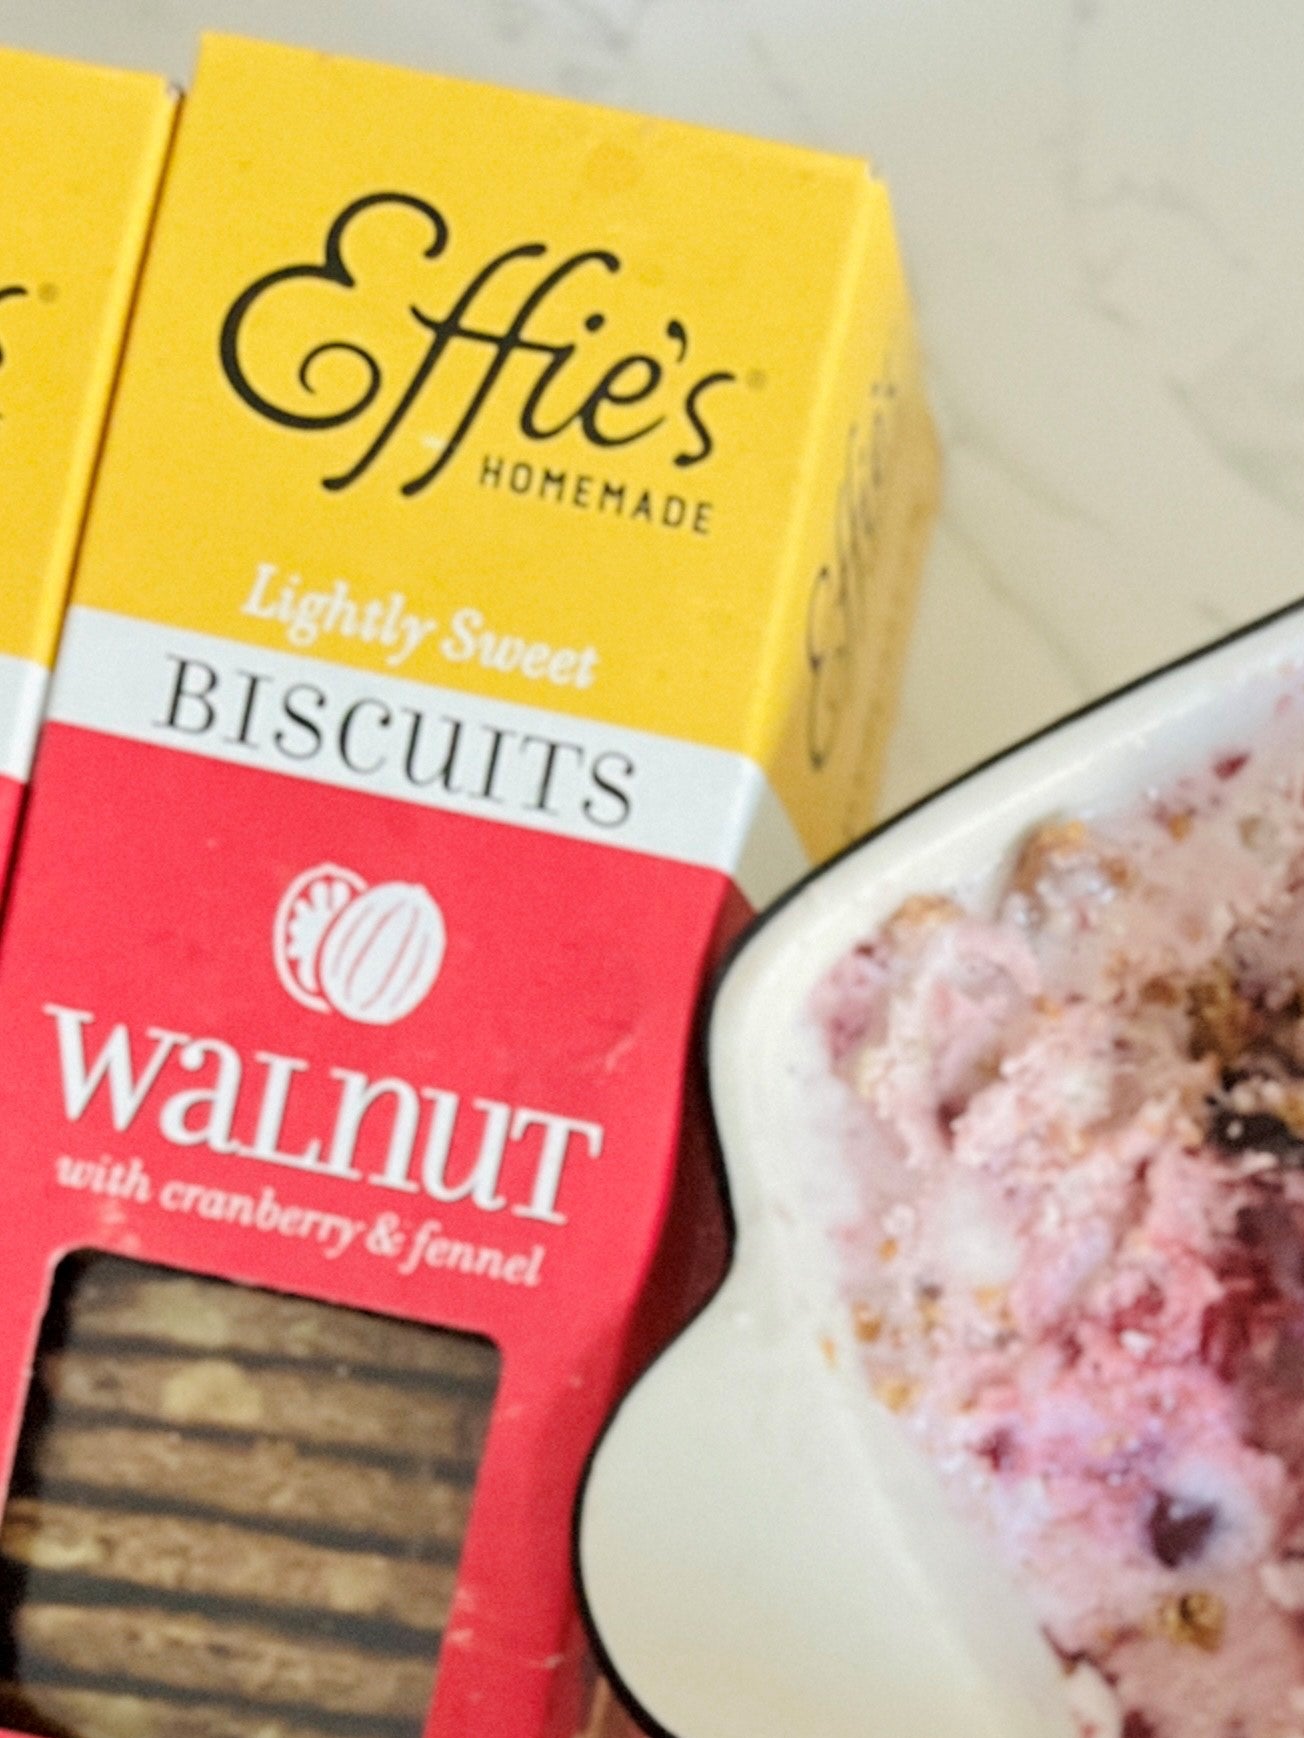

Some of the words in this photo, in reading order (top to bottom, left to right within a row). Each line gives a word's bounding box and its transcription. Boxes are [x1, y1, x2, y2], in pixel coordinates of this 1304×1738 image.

[219, 191, 738, 498] Effie's
[479, 455, 715, 537] HOMEMADE
[241, 562, 436, 667] Lightly
[441, 607, 600, 690] Sweet
[152, 652, 637, 831] BISCUITS
[55, 1154, 152, 1204] with
[160, 1179, 366, 1259] cranberry
[364, 1211, 406, 1257] &
[398, 1221, 546, 1287] fennel
